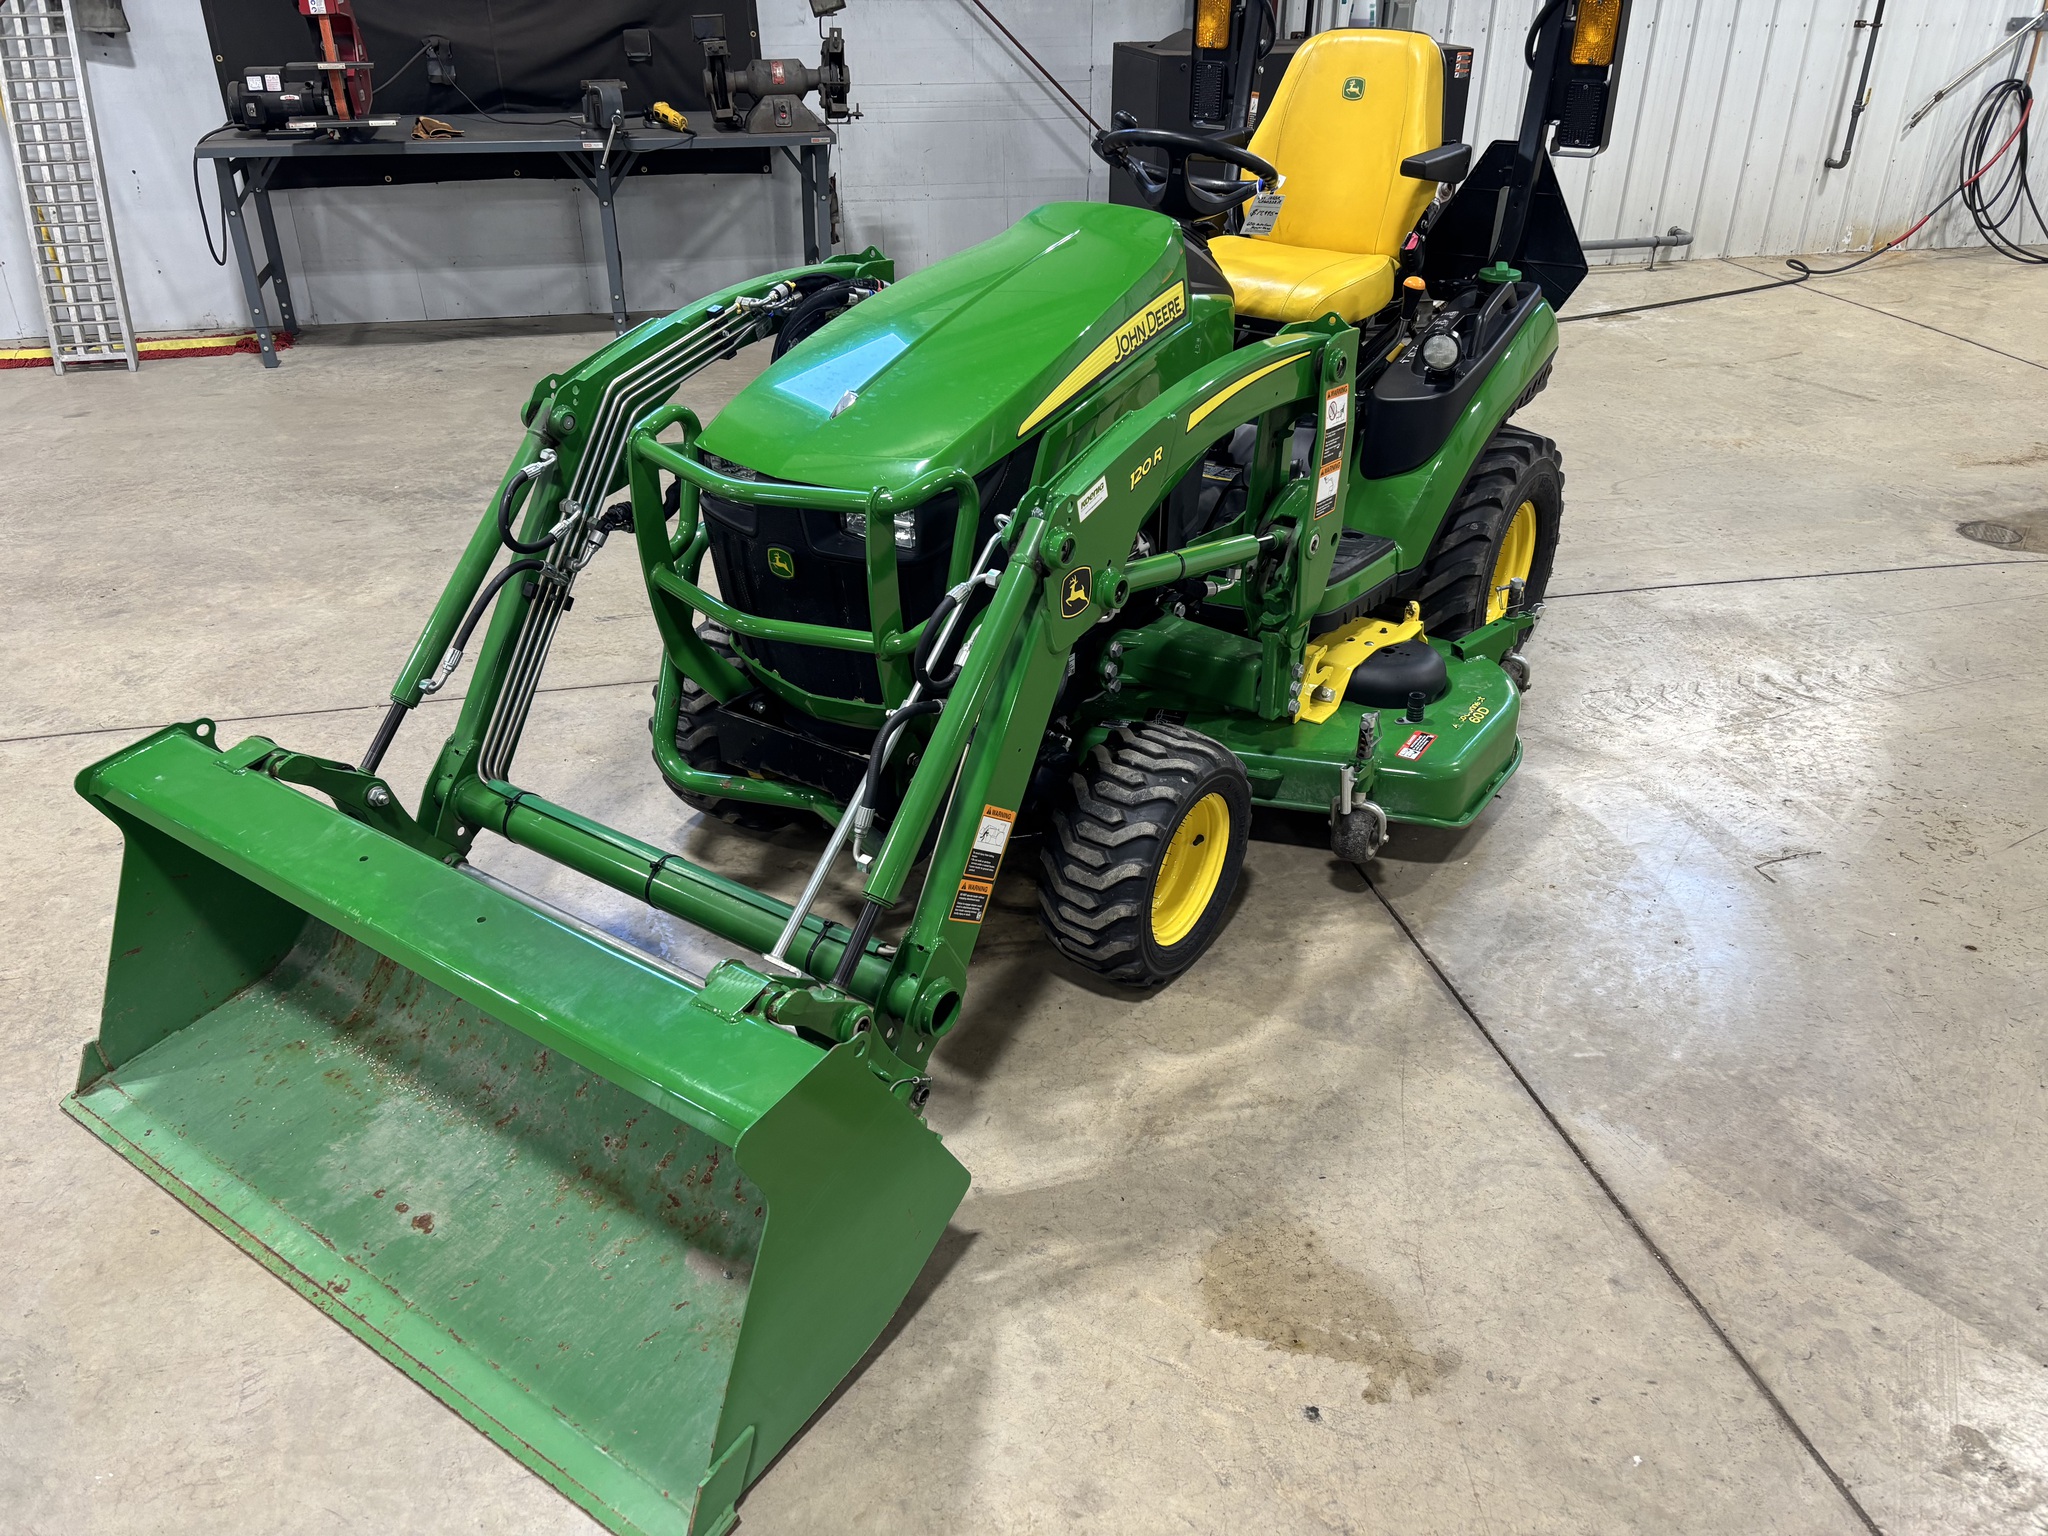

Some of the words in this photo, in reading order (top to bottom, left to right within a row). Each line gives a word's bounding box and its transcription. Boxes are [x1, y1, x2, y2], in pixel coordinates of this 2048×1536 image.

[1114, 321, 1147, 360] JOHN
[1146, 295, 1182, 334] DEERE
[1468, 706, 1490, 724] 60D
[991, 809, 1012, 820] WARNING
[967, 884, 989, 893] WARNING
